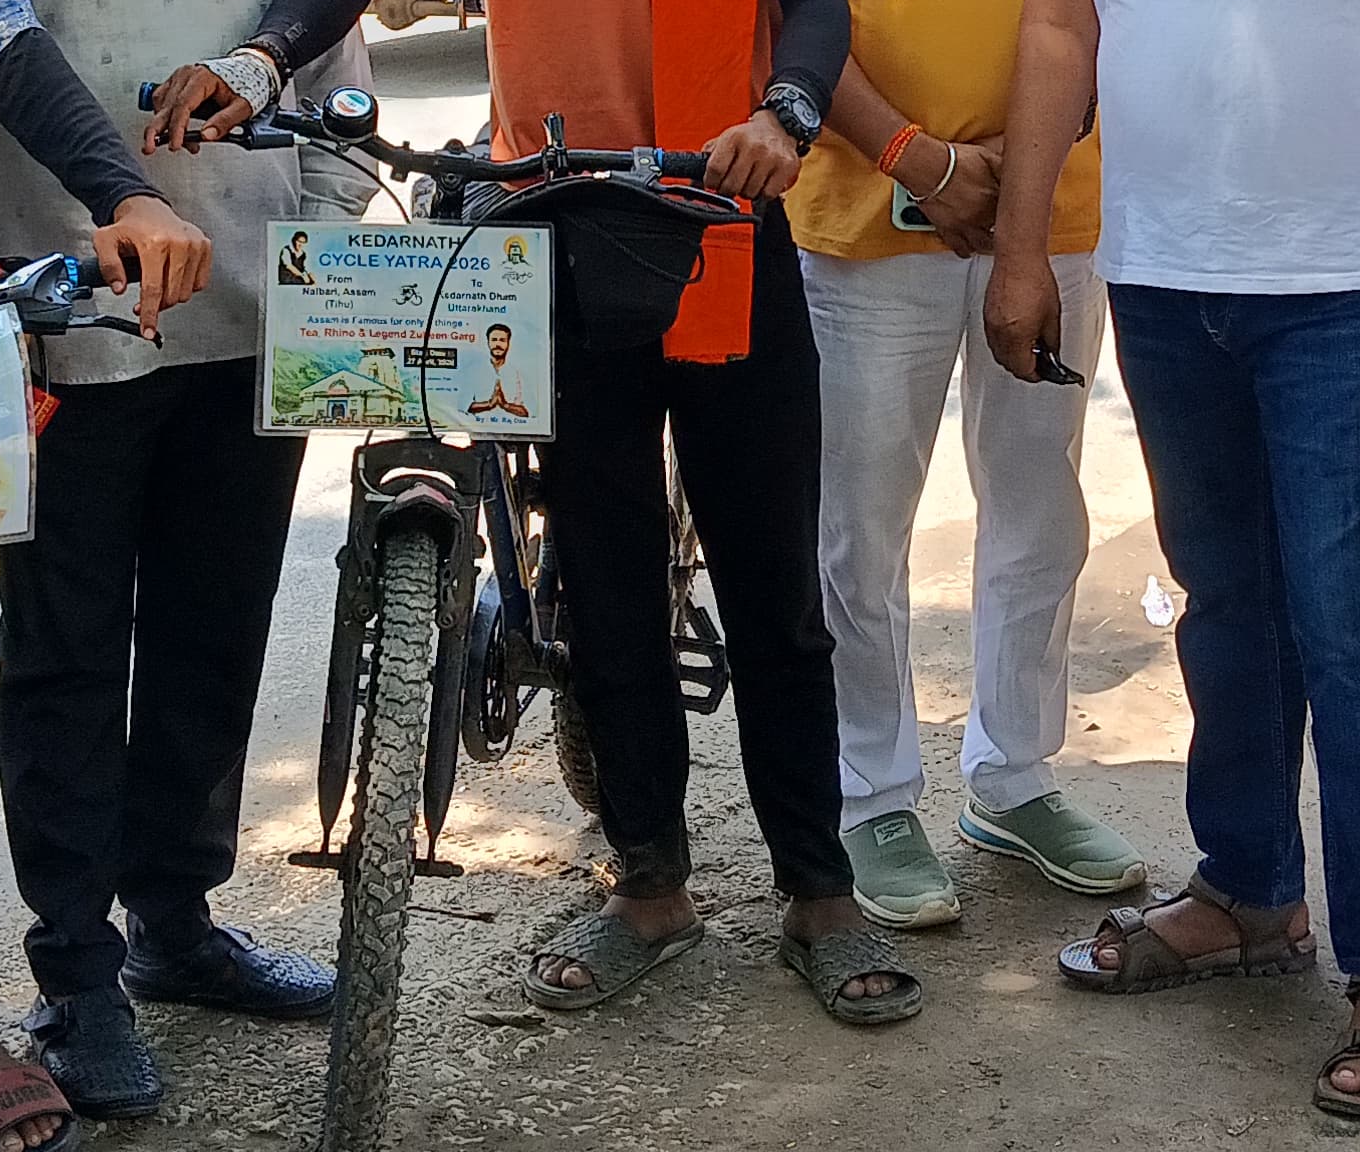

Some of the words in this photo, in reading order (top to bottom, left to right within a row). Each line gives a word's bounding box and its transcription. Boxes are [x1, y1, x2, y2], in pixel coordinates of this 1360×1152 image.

[348, 234, 462, 249] KEDARNATH
[319, 253, 380, 267] CYCLE
[384, 254, 443, 269] YATRA
[448, 256, 490, 270] 2026
[327, 274, 353, 283] From
[342, 288, 376, 296] Assam
[325, 299, 354, 310] (Tihu)
[448, 304, 507, 314] Uttarakhand
[405, 318, 424, 328] only
[324, 328, 355, 337] Rhino
[369, 329, 406, 340] Legend
[409, 330, 447, 340] Zueen
[450, 332, 476, 342] Garg
